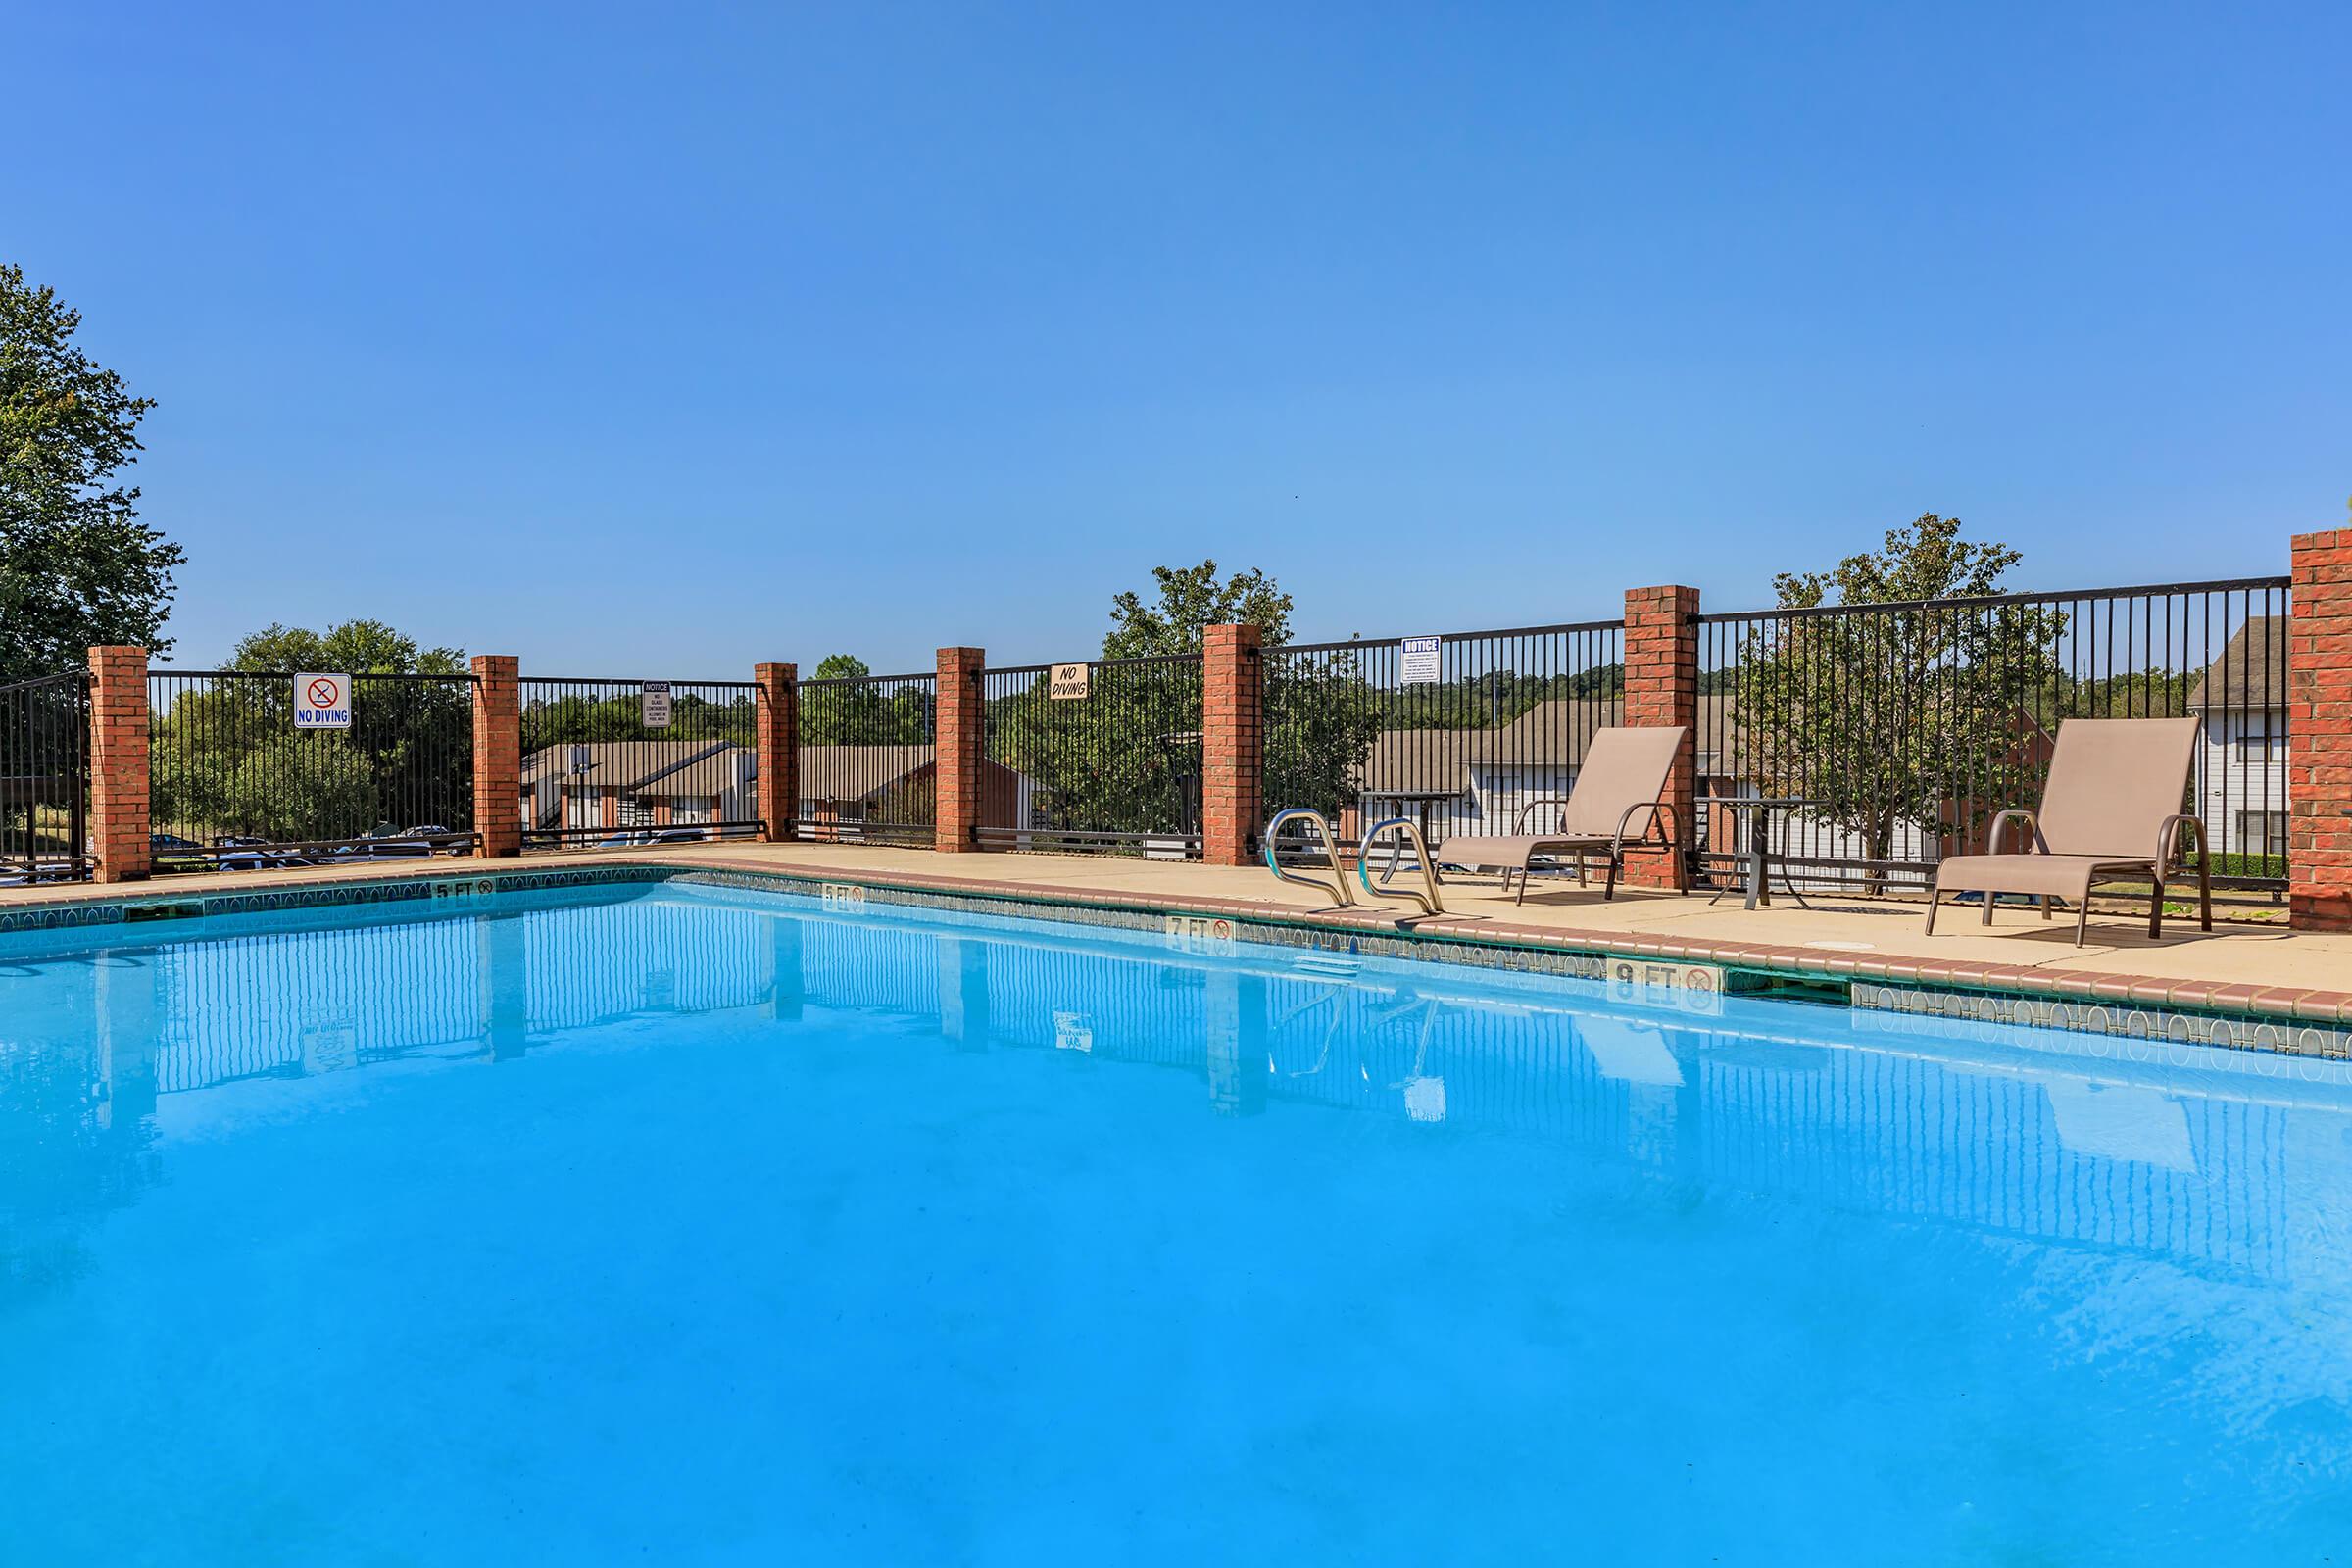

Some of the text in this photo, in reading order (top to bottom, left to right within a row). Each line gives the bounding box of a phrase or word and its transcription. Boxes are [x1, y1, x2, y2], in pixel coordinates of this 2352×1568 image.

[1405, 639, 1438, 652] NOTICE
[1059, 667, 1077, 680] NO
[1052, 682, 1086, 696] DIVING
[298, 709, 348, 723] NO DIVING
[437, 882, 473, 898] 5 FT
[825, 885, 849, 901] 5 FT
[1171, 917, 1208, 938] 7 FT
[1616, 963, 1677, 988] 9 FT
